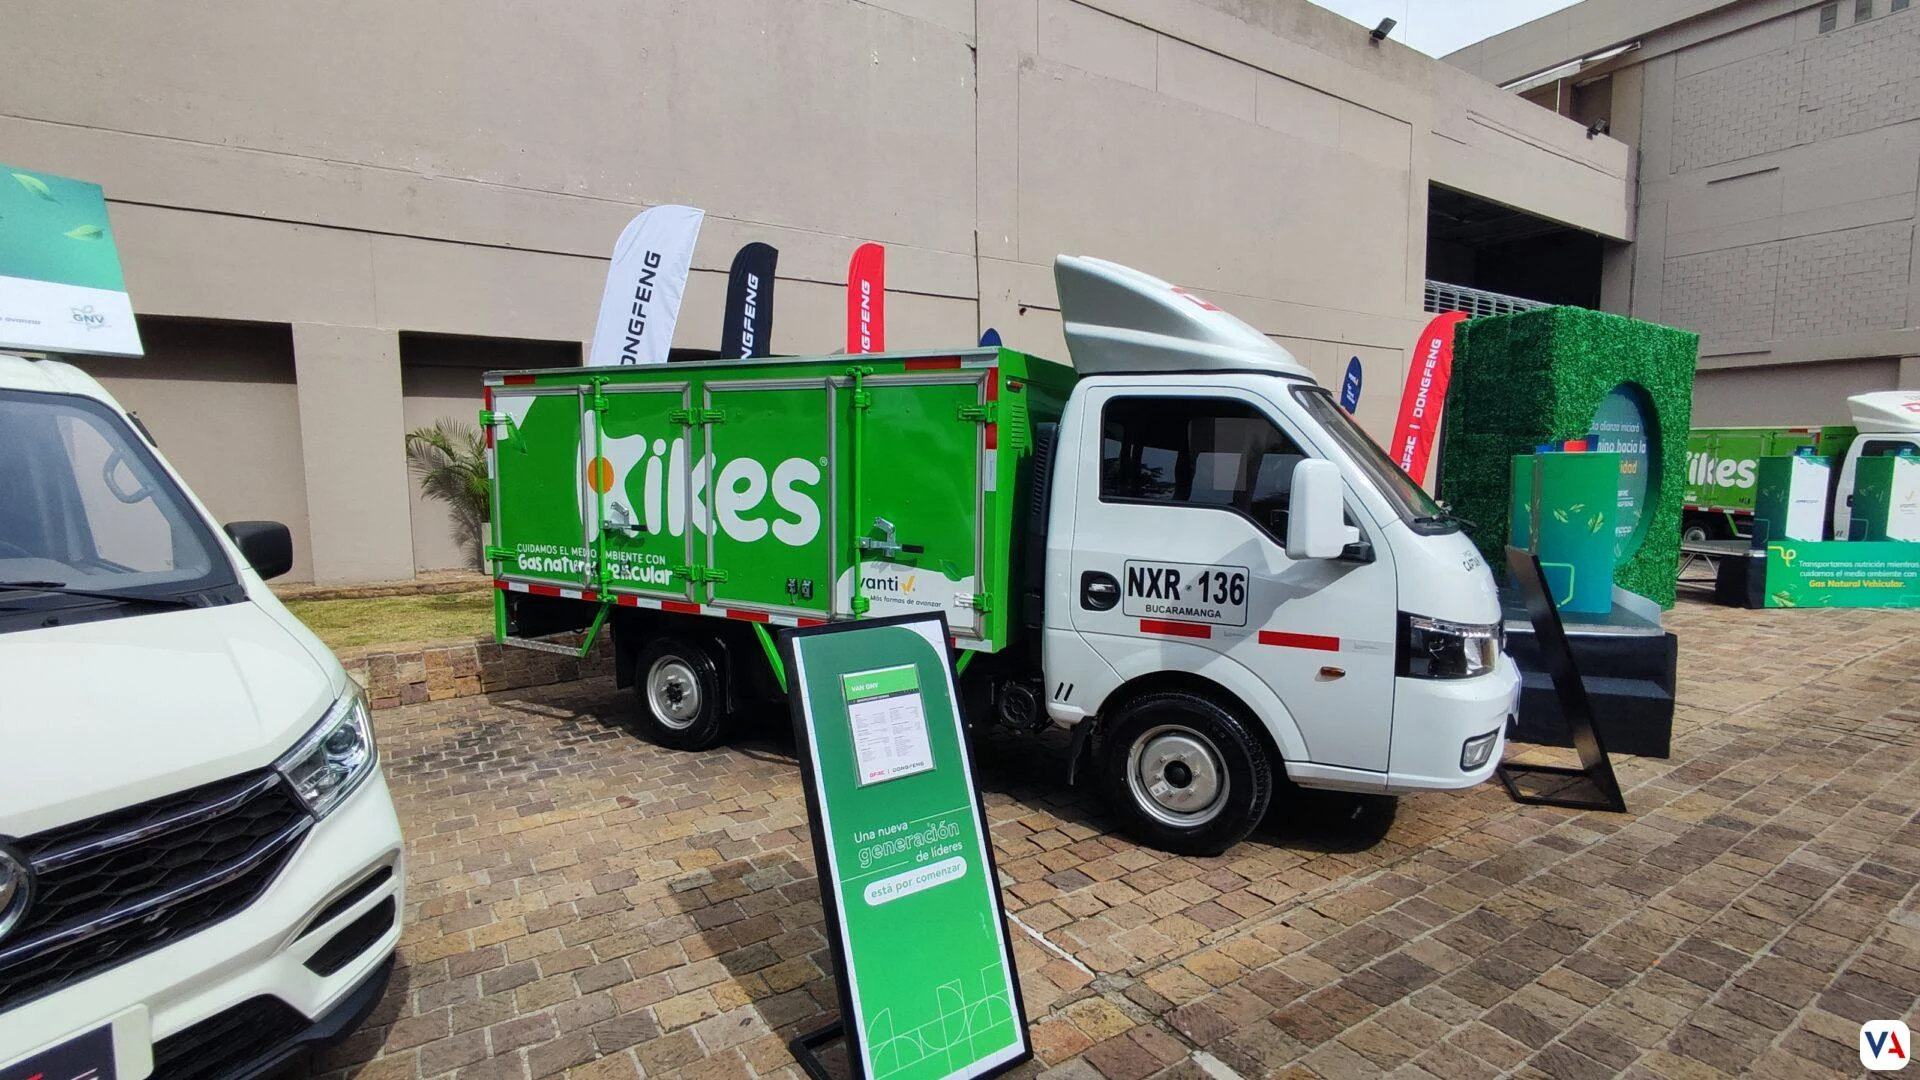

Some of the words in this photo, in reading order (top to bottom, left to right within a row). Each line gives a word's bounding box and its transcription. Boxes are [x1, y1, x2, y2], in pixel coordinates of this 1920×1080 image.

[621, 250, 662, 365] ONGFENG
[740, 272, 760, 360] NGFENG
[861, 279, 872, 353] GFENG
[73, 313, 104, 324] GNV
[1412, 338, 1442, 419] DONGFENG
[1617, 439, 1638, 454] hacia
[1639, 440, 1647, 454] la
[576, 409, 821, 547] Kikes
[1687, 450, 1757, 489] ikes
[517, 543, 557, 555] CUIDAMOS
[560, 545, 569, 556] EL
[571, 547, 597, 559] MEDIO
[605, 550, 646, 562] MBIENTE
[646, 554, 666, 565] CON
[518, 553, 542, 571] Gas
[1799, 560, 1853, 569] Transportamos
[1854, 560, 1885, 568] nutrición
[1809, 580, 1826, 588] Gas
[1827, 580, 1861, 588] Natural
[1867, 570, 1902, 578] ambiente
[1128, 566, 1181, 600] NXR
[1198, 570, 1245, 606] 136
[884, 595, 905, 604] formas
[1145, 604, 1222, 618] BUCARAMANGA
[854, 831, 876, 843] Una
[878, 822, 908, 837] nueva
[858, 820, 960, 868] generación
[916, 850, 929, 862] de
[931, 841, 963, 858] líderes
[871, 883, 893, 898] está
[895, 878, 913, 893] por
[916, 863, 961, 883] comenzar
